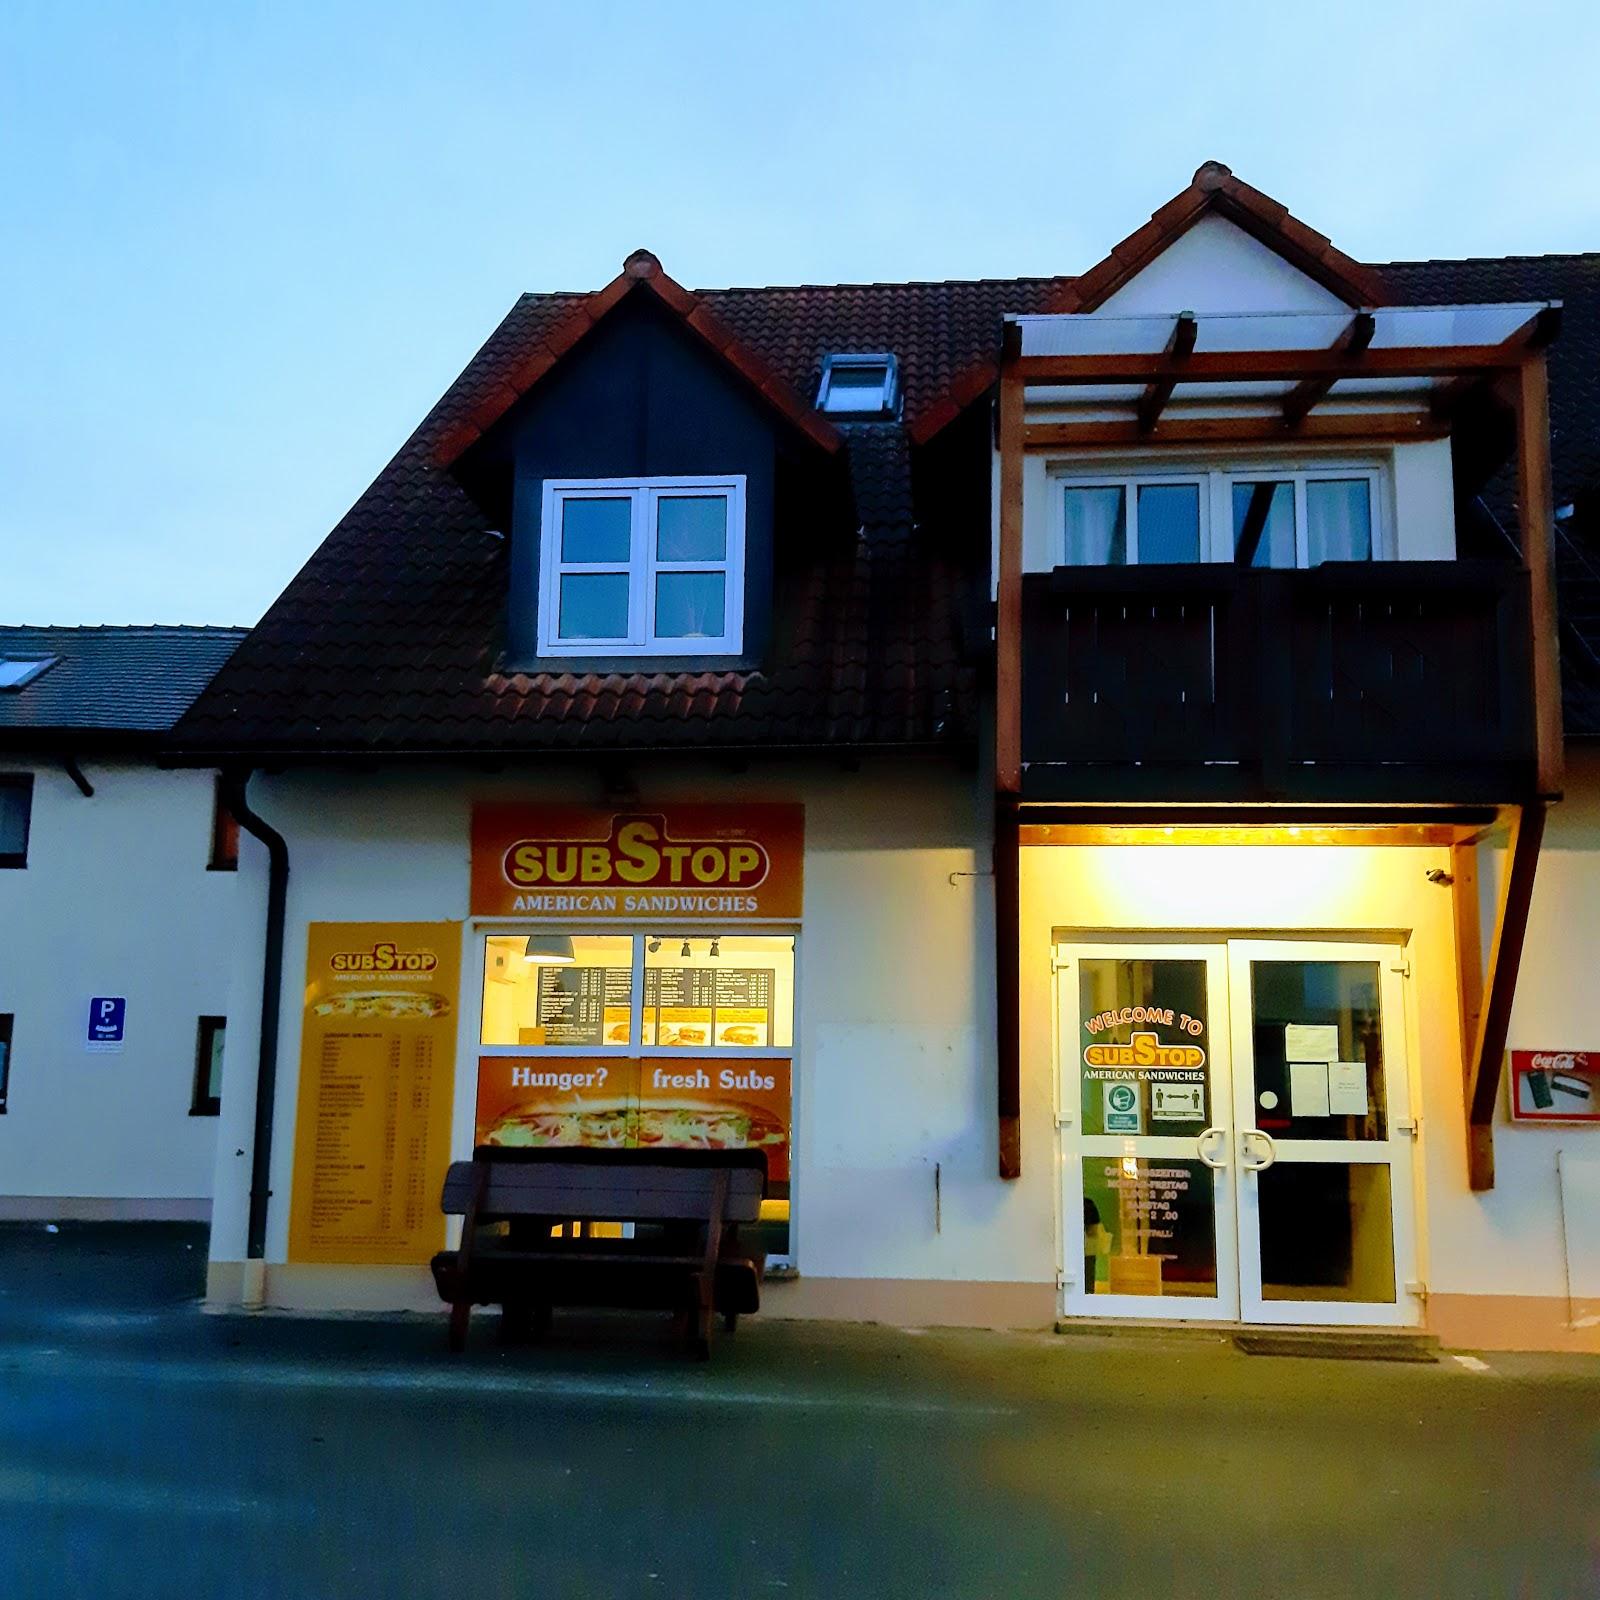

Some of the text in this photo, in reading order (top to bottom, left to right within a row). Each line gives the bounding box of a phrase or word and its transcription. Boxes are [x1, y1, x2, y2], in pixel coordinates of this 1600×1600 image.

[512, 895, 758, 912] AMERICAN SANDWICHES
[100, 1000, 115, 1018] P
[1084, 1006, 1203, 1036] WELCOME TO
[511, 1067, 609, 1091] Hunger?
[652, 1069, 775, 1089] fresh Subs
[1083, 1070, 1205, 1081] AMERICAN SANDWICHES
